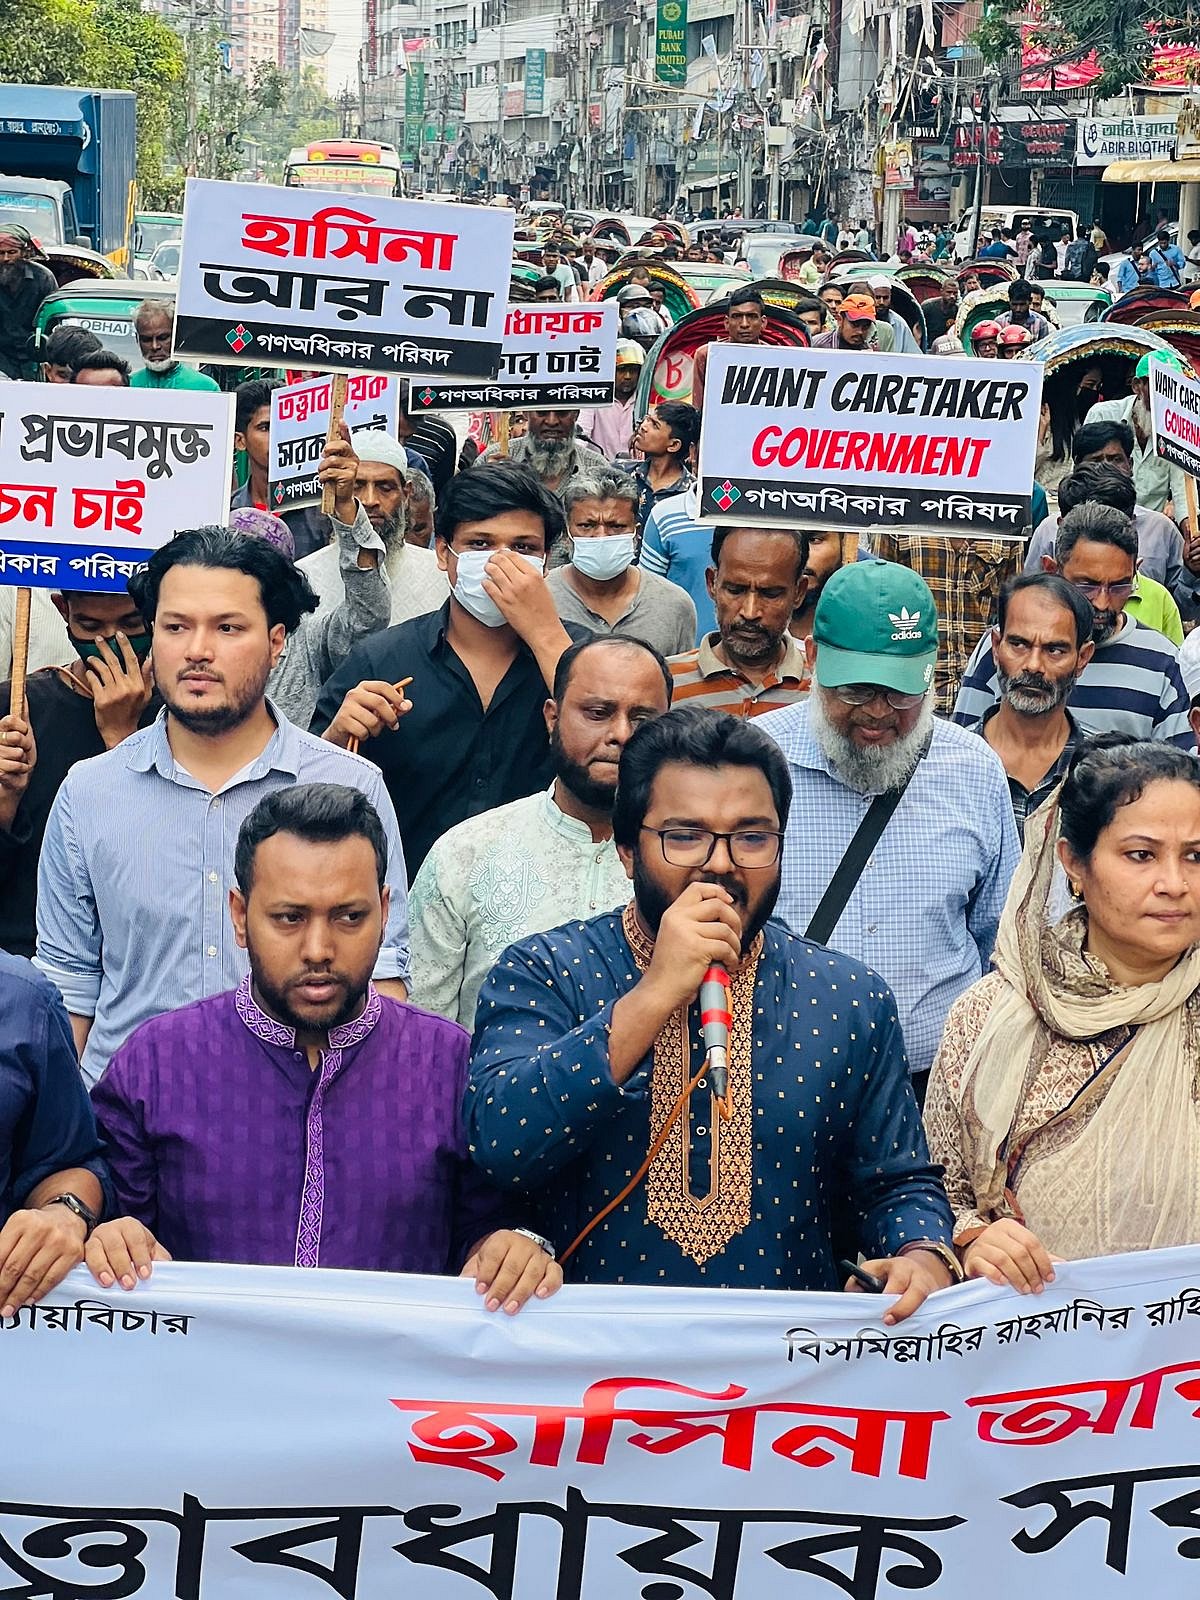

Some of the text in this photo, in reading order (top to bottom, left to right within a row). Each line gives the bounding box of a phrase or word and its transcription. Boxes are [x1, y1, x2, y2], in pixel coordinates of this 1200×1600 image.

[658, 30, 684, 40] PUBALI
[660, 43, 682, 52] BANK
[1100, 140, 1177, 154] ABIR BROTHE
[241, 206, 459, 271] হাসিনা
[199, 263, 495, 328] আর না
[80, 319, 128, 334] OBHAI
[504, 309, 605, 339] ধায়ক
[256, 333, 454, 367] গণঅধিকার পরিষদ
[546, 346, 602, 374] চাই
[438, 384, 610, 403] গণঅধিকার পরিষদ
[721, 365, 1029, 421] WANT CARETAKER
[1155, 368, 1200, 416] WANT CARE
[20, 414, 214, 480] প্রভাবমুক্ত
[751, 425, 992, 478] GOVERNMENT
[72, 480, 146, 535] চাই
[744, 487, 1025, 524] গণঅধিকার পরিষদ
[891, 631, 922, 640] adidas
[783, 1327, 987, 1363] বিসমিল্লাহির
[994, 1298, 1136, 1345] রাহমানির
[390, 1377, 950, 1480] হাসিনা
